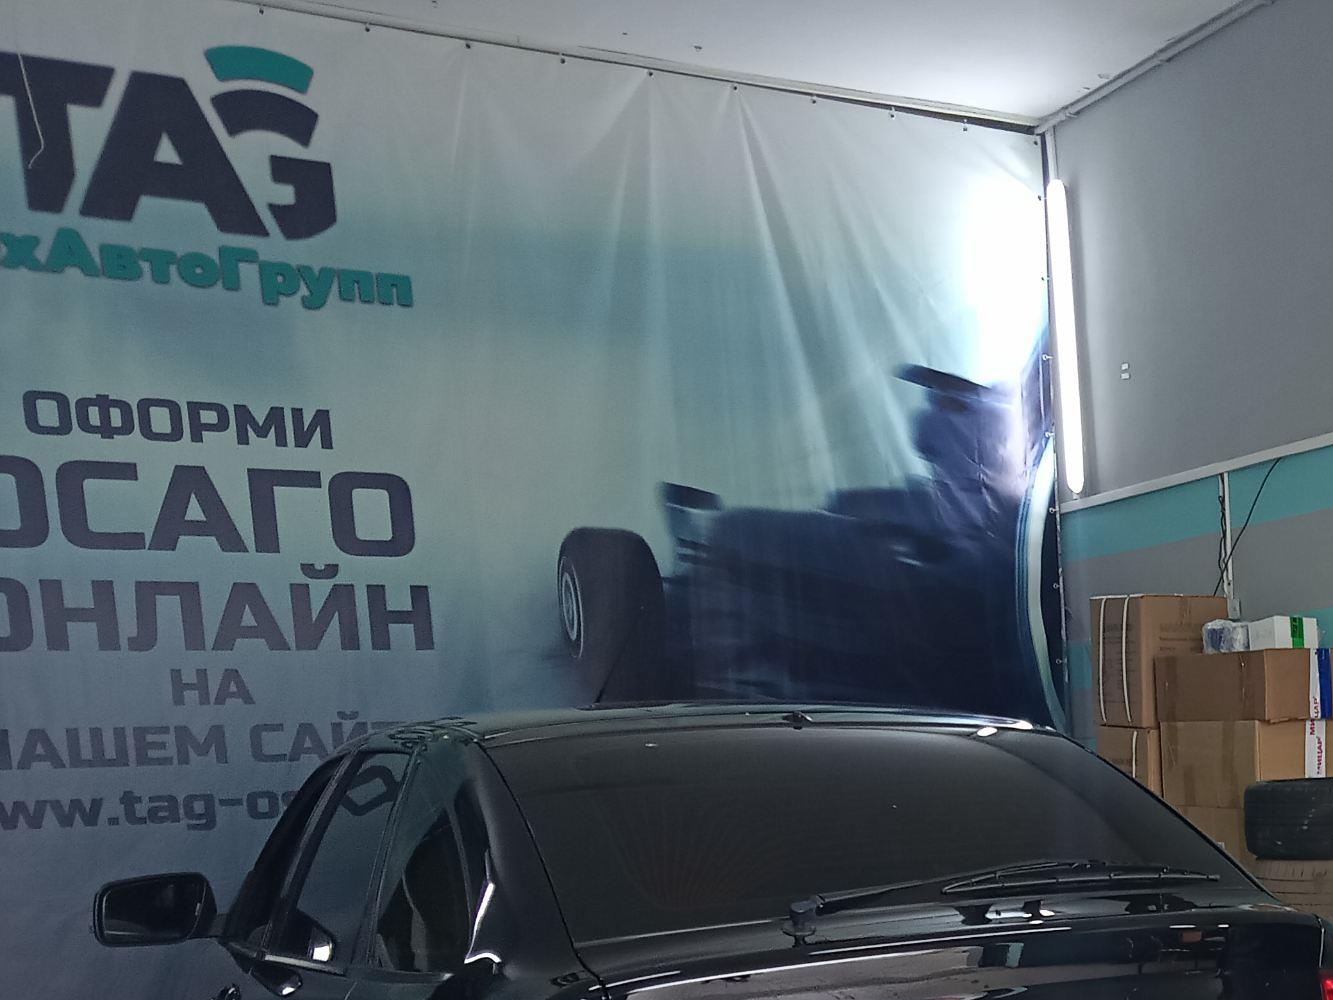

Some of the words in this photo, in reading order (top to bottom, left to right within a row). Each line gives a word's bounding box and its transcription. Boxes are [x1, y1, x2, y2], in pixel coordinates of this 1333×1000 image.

[22, 389, 334, 450] ОФОРМИ
[0, 455, 416, 558] ОСАГО
[169, 668, 256, 706] НА
[0, 722, 229, 771] АШЕМ
[248, 710, 422, 763] САЙ
[0, 789, 300, 831] ww.tag-o
